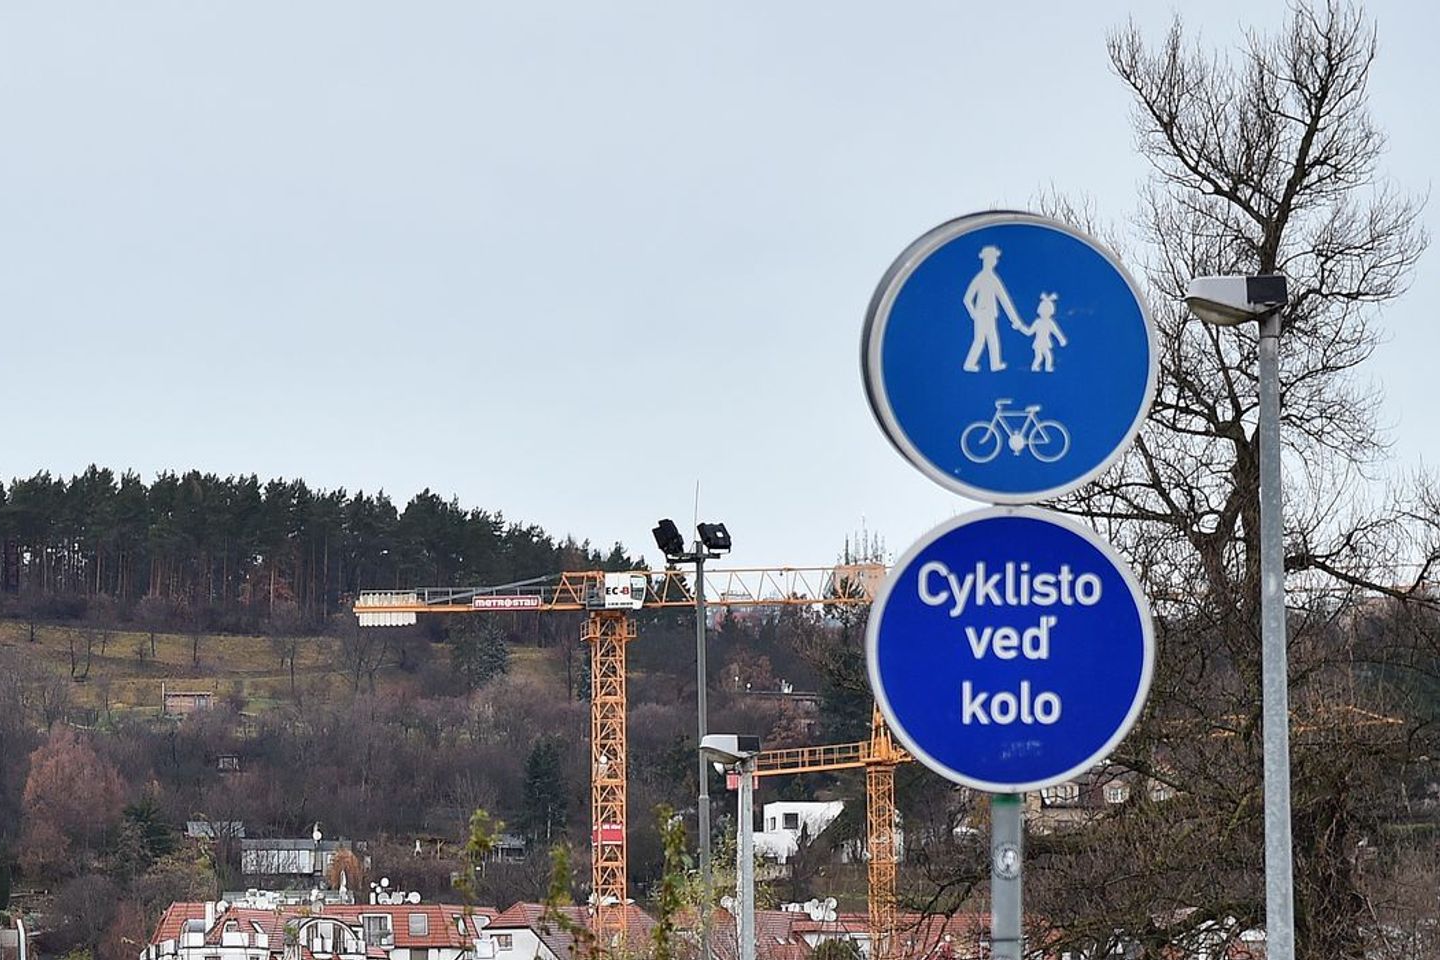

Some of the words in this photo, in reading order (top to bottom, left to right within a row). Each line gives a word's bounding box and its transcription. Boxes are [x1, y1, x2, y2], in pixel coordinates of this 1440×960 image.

[917, 560, 1103, 618] Cyklisto
[964, 615, 1058, 660] veď
[961, 680, 1062, 725] kolo
